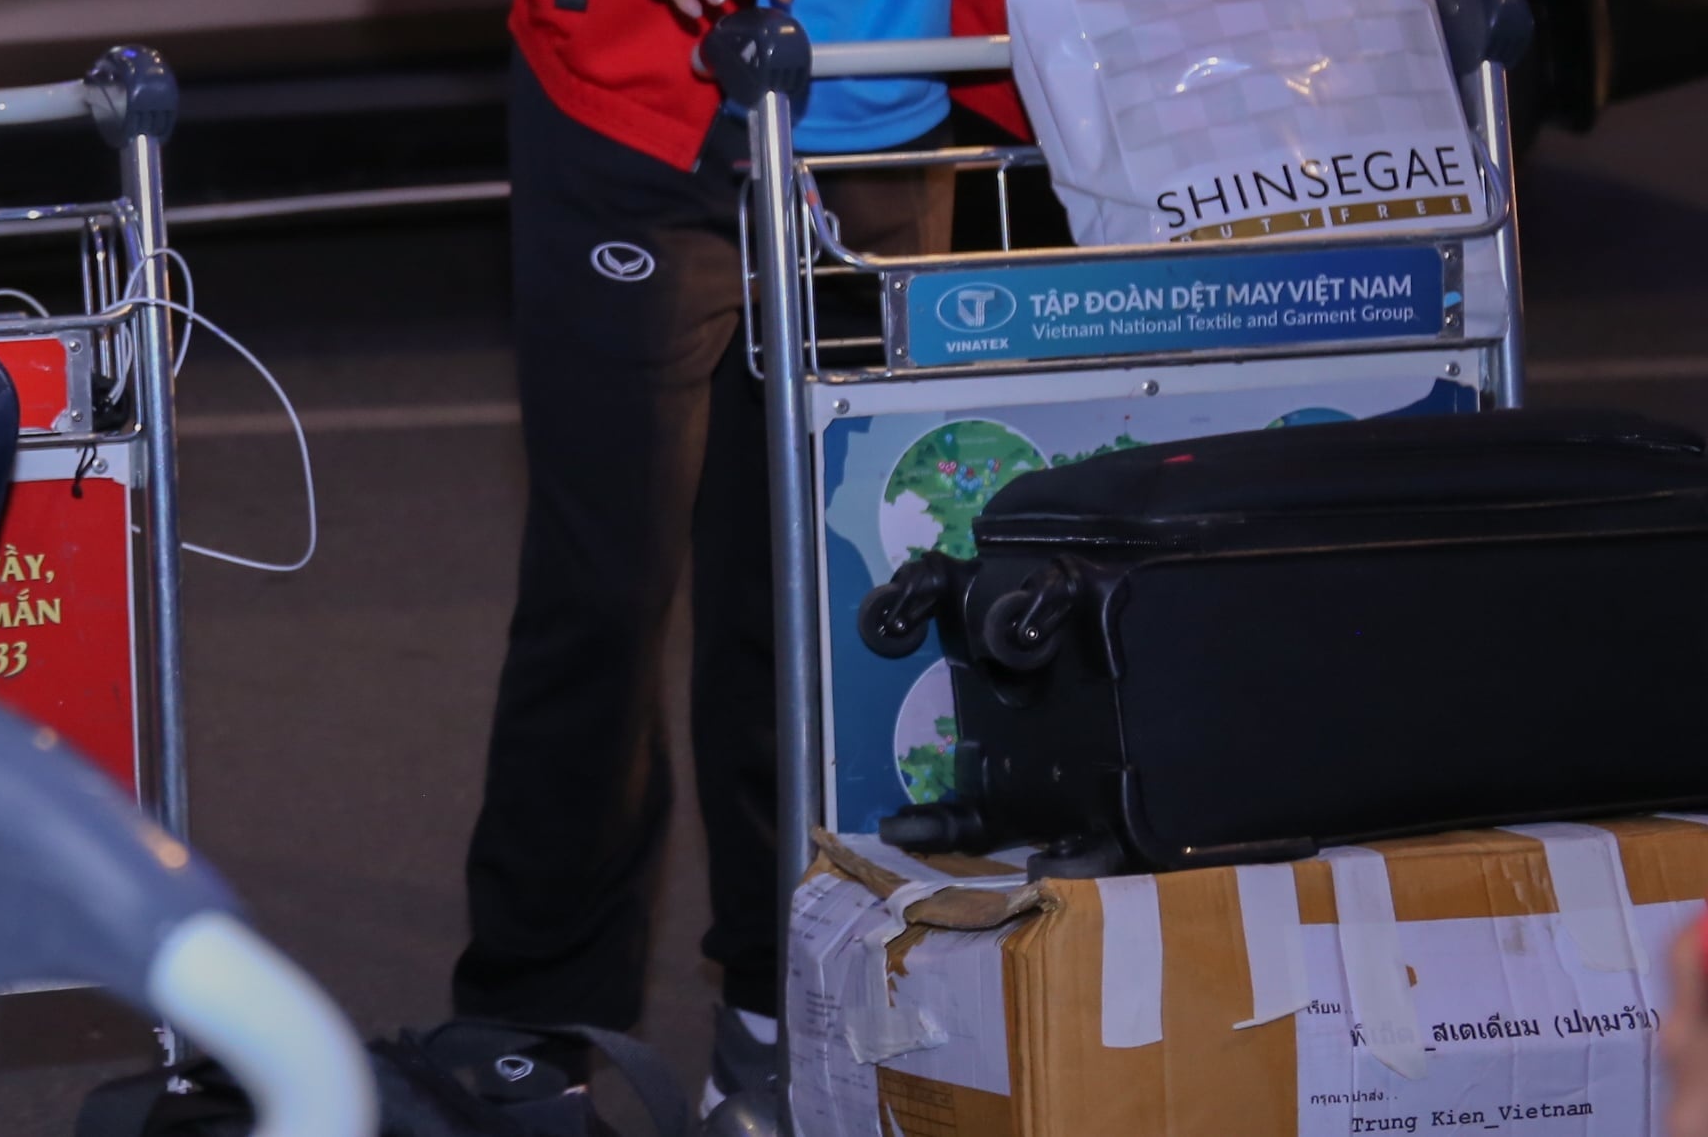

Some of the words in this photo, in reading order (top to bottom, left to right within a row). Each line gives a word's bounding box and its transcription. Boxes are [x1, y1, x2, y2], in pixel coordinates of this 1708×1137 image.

[1156, 146, 1466, 228] SHINSEGAE
[1341, 199, 1462, 223] FREE
[1030, 289, 1079, 321] TẬP
[1084, 283, 1164, 314] ĐOÀN
[1171, 280, 1220, 312] DỆT
[1226, 280, 1284, 306] MAY
[1287, 273, 1344, 306] VIỆT
[1350, 274, 1412, 299] NAM
[1032, 320, 1104, 341] Vietnam
[1110, 315, 1181, 336] National
[1187, 314, 1242, 332] Textile
[1247, 310, 1278, 329] and
[1283, 308, 1356, 328] Garment
[1362, 304, 1414, 323] Group
[946, 338, 1009, 353] VINATEX
[1352, 1115, 1418, 1133] Trung
